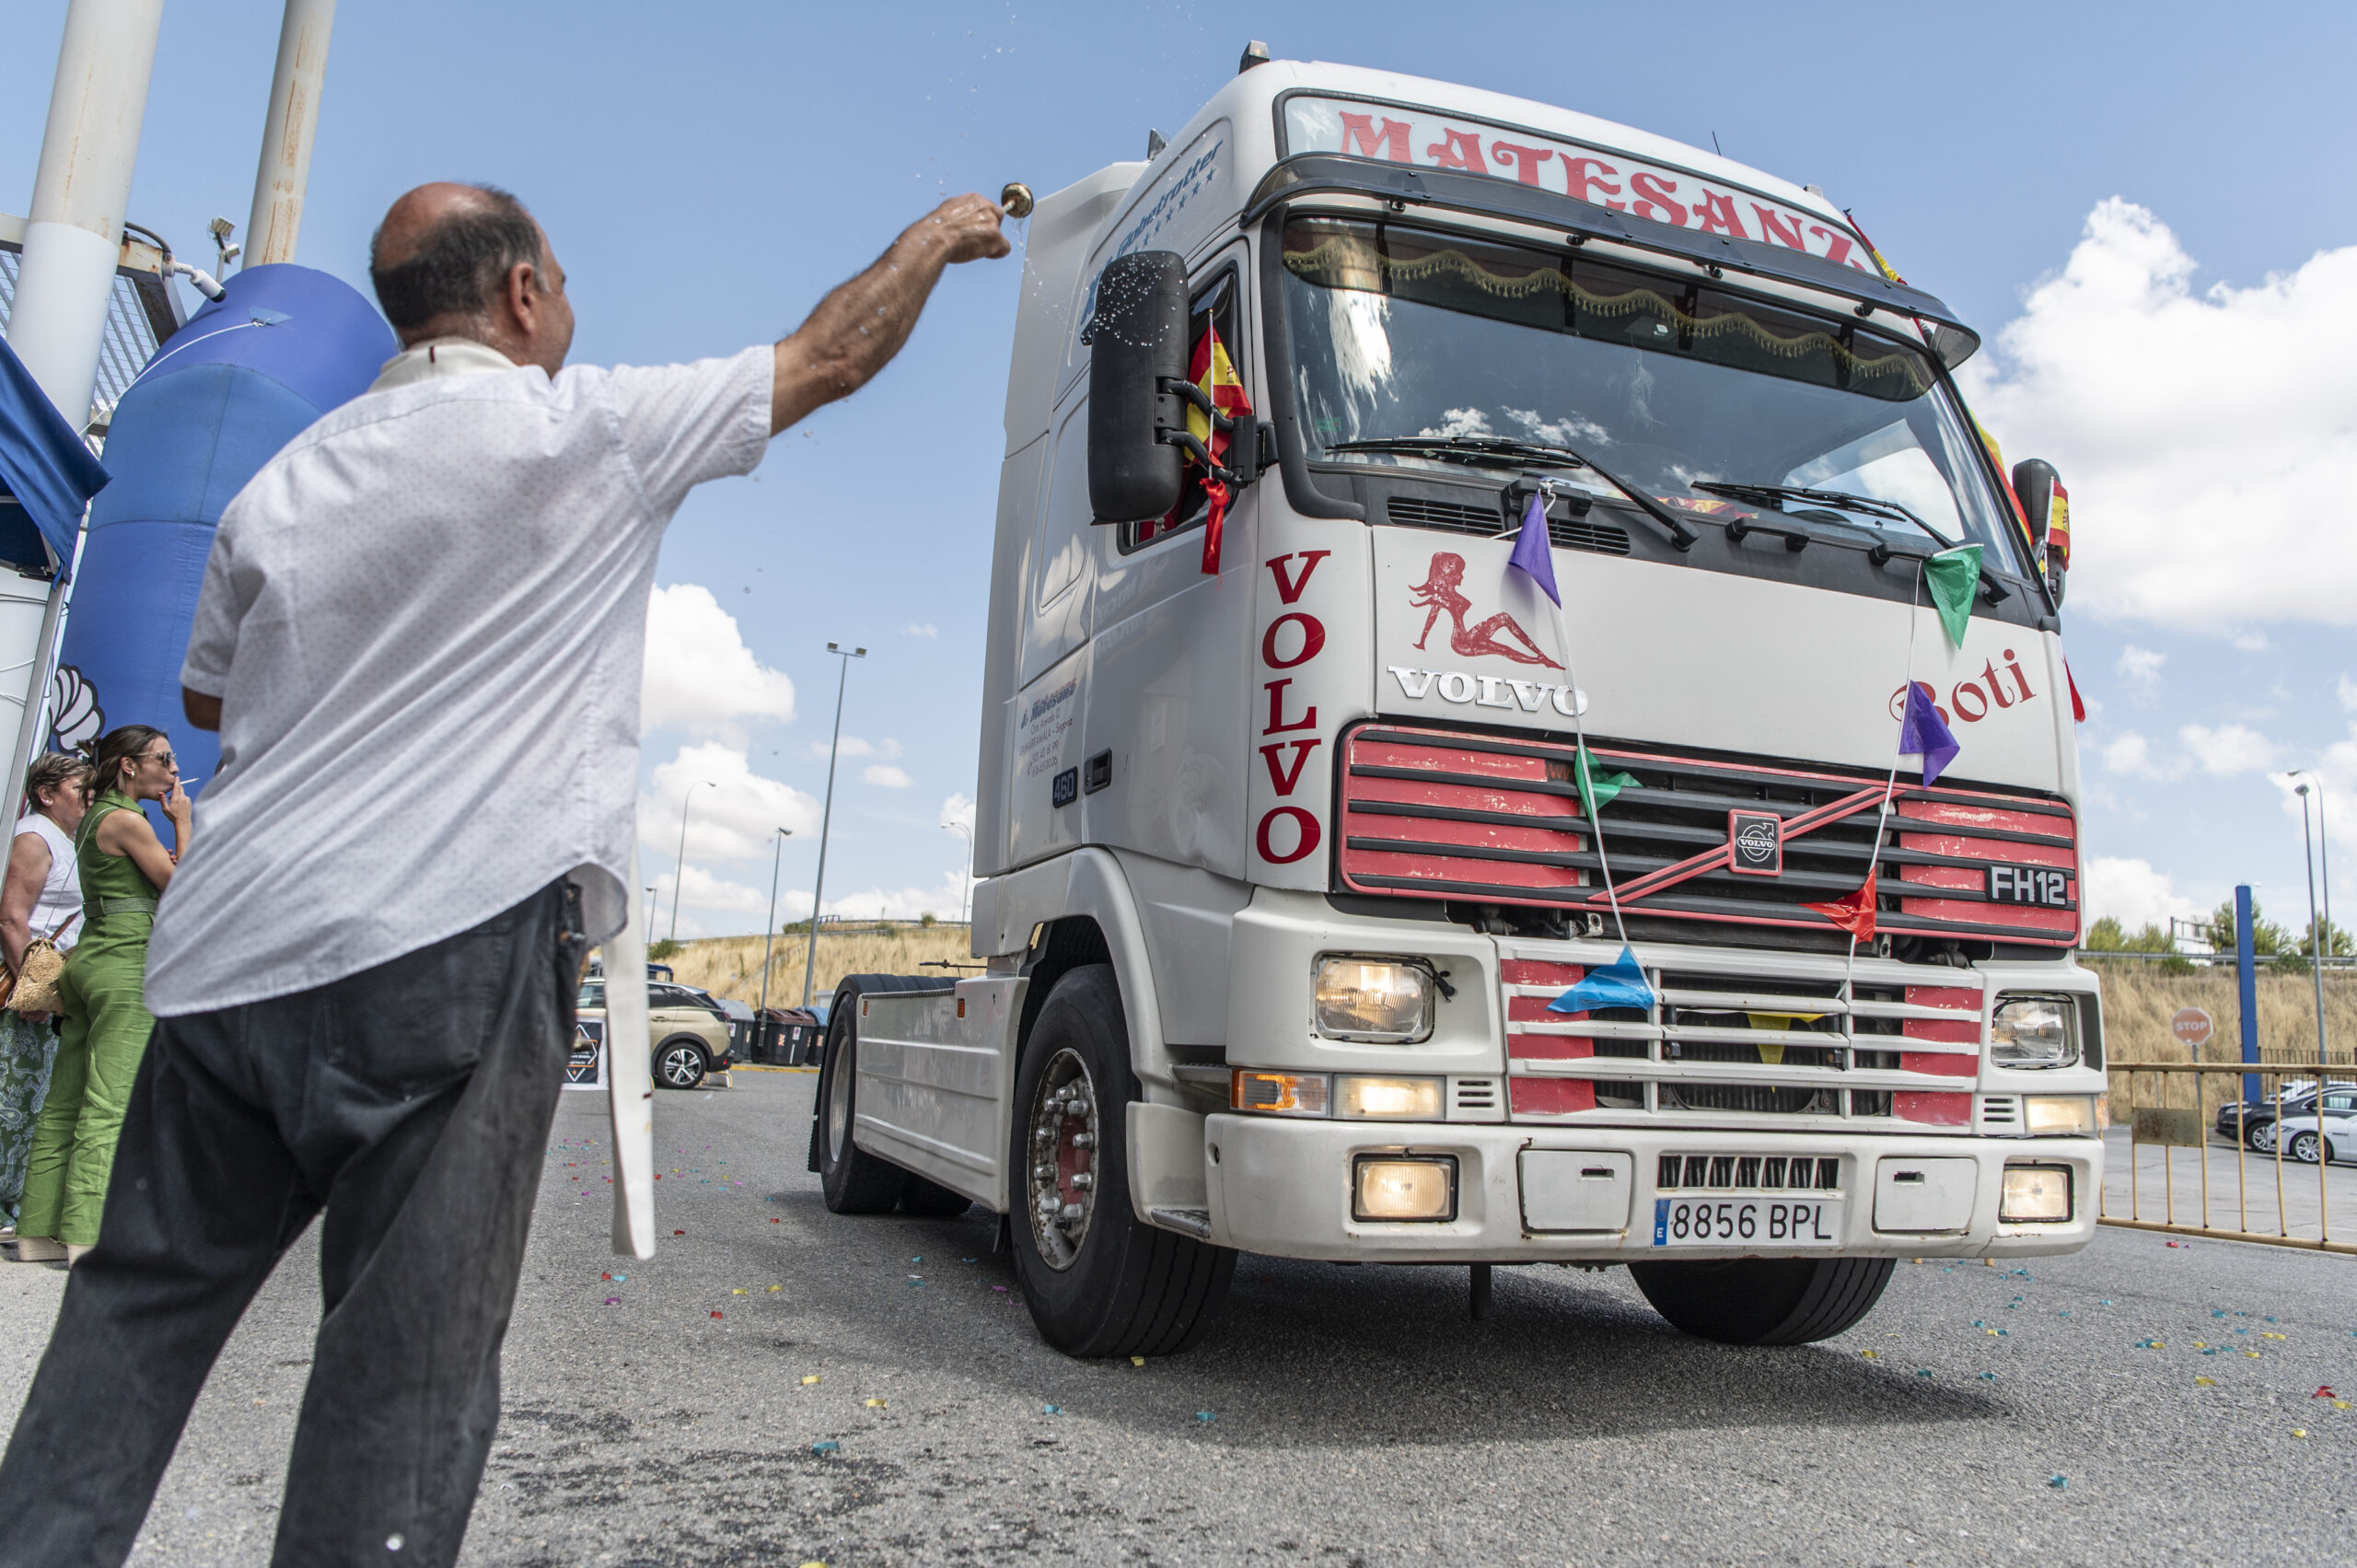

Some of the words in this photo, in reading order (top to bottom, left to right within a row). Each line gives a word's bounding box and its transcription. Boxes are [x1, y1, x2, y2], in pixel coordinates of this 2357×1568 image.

[1339, 110, 1866, 271] MATESANZ
[1256, 550, 1331, 865] VOLVO
[1387, 666, 1588, 716] VOLVO
[1053, 772, 1074, 804] 460
[1740, 839, 1773, 848] VOLVO
[1991, 866, 2066, 906] FH12
[2176, 1020, 2207, 1032] STOP
[1655, 1227, 1664, 1238] E
[1673, 1203, 1757, 1239] 8856
[1769, 1204, 1832, 1240] BPL
